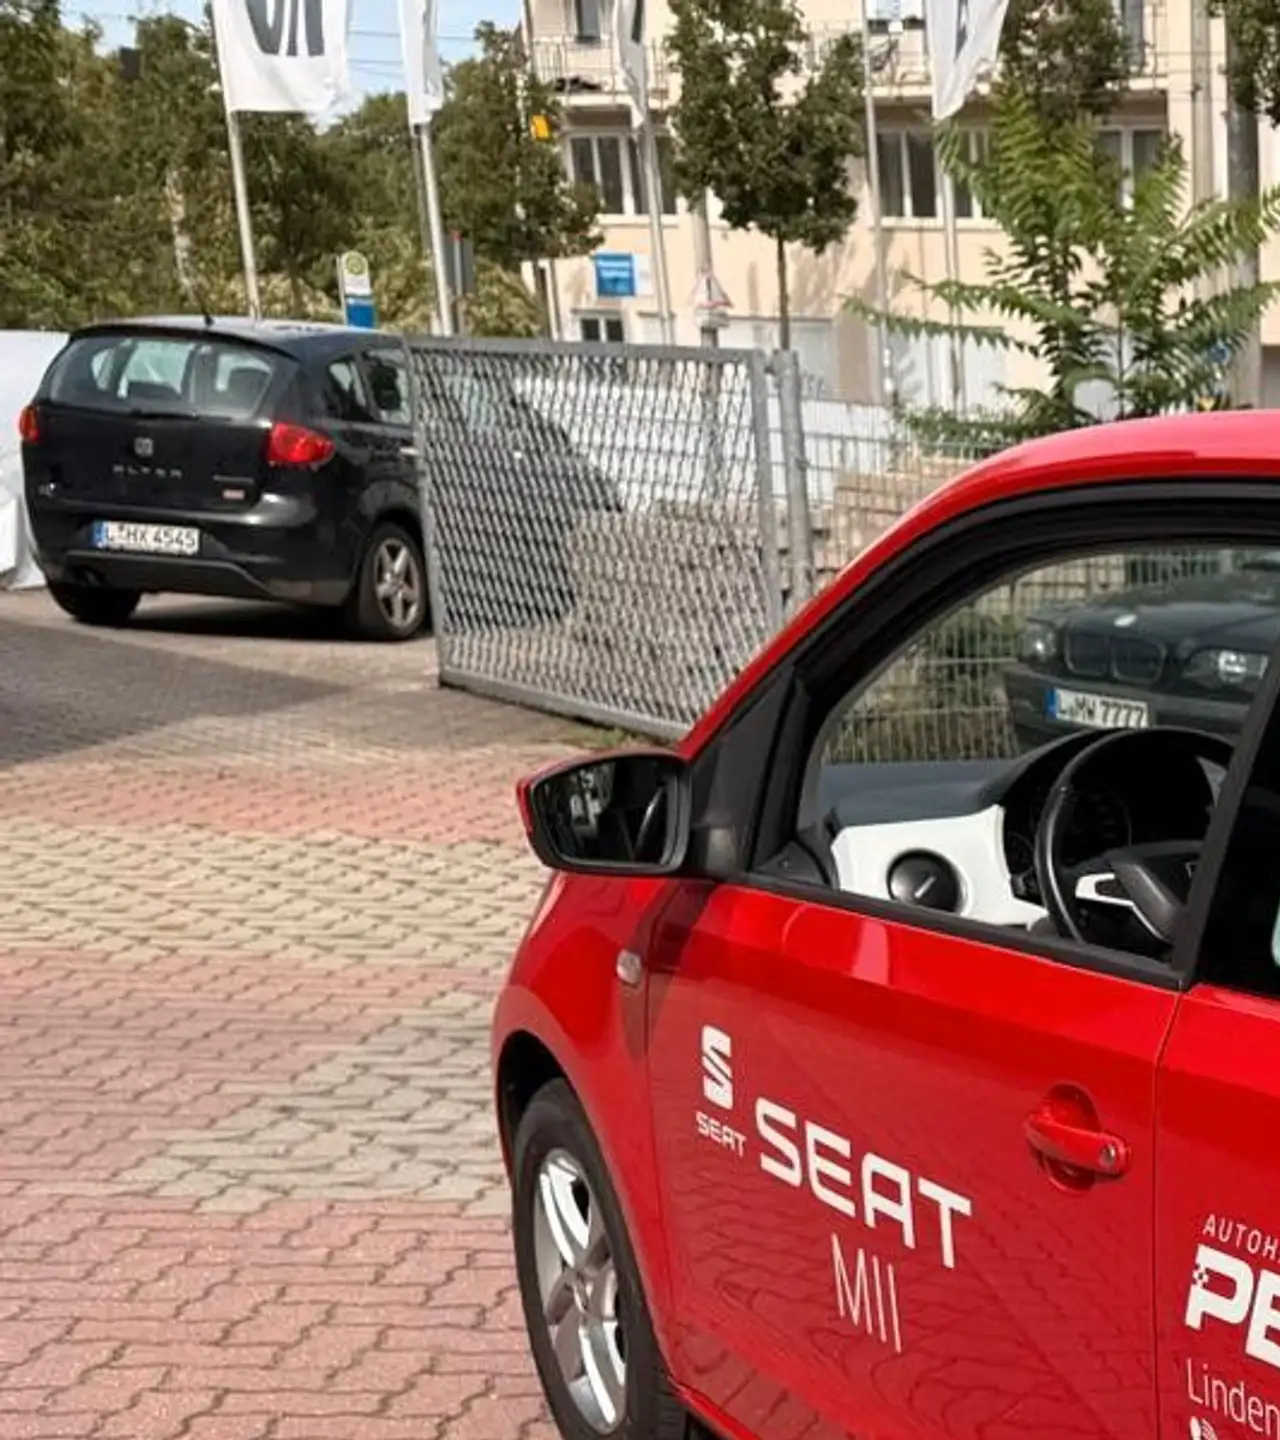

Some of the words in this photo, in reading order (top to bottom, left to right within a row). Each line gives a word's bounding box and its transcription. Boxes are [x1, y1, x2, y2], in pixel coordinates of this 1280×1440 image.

[153, 528, 196, 549] 4545
[1100, 699, 1145, 729] 7777
[694, 1109, 748, 1158] SEAT
[754, 1096, 974, 1269] SEAT
[831, 1232, 902, 1355] MII
